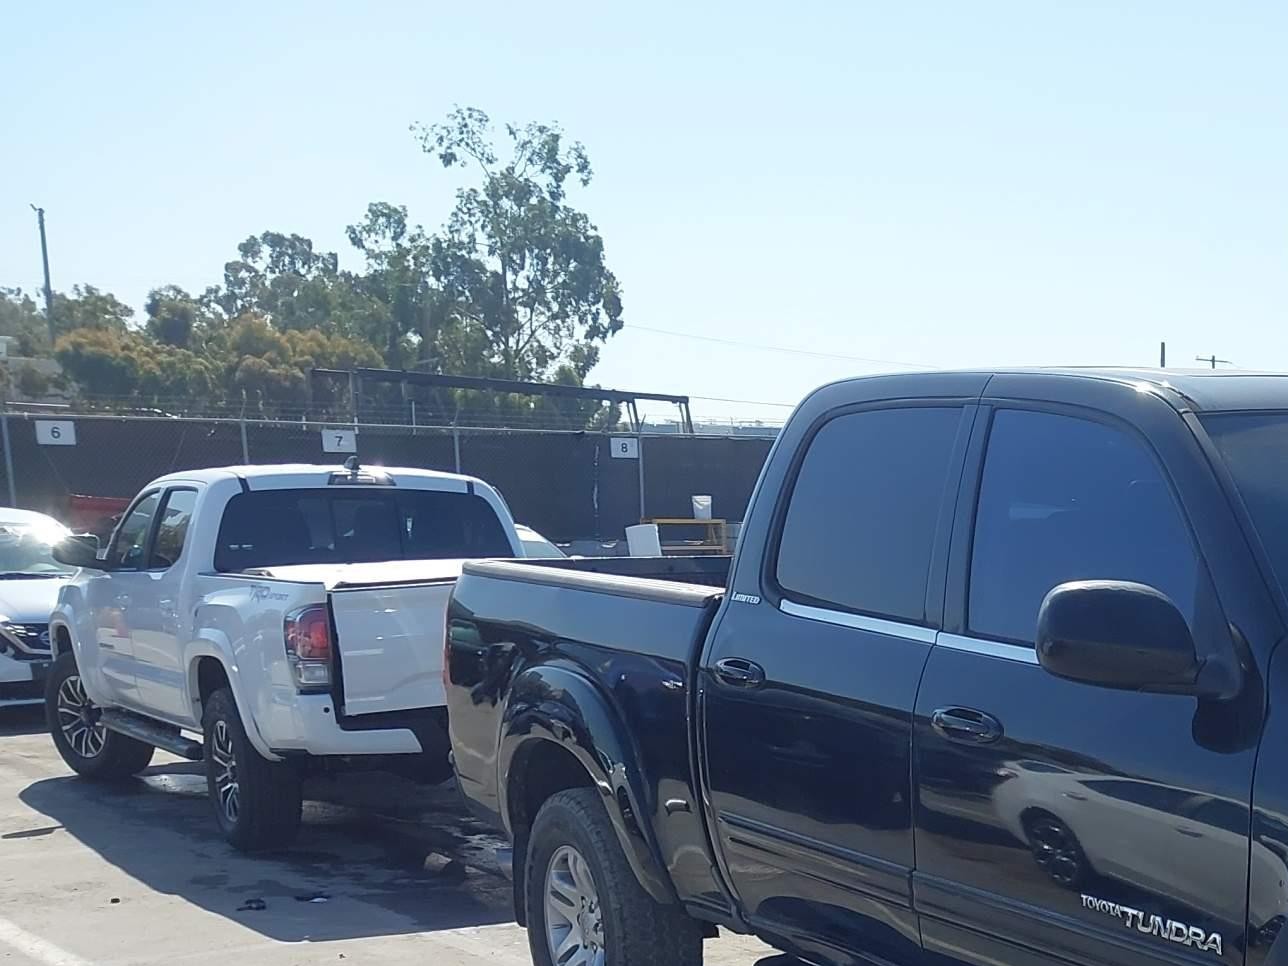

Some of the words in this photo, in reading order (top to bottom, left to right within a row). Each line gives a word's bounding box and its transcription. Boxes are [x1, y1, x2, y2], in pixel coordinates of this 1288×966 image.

[51, 426, 61, 439] 6
[334, 435, 344, 447] 7
[621, 442, 628, 453] 8
[731, 591, 760, 604] LIMITED
[1081, 893, 1122, 918] TOYOTA
[1120, 906, 1222, 955] TUNDRA
